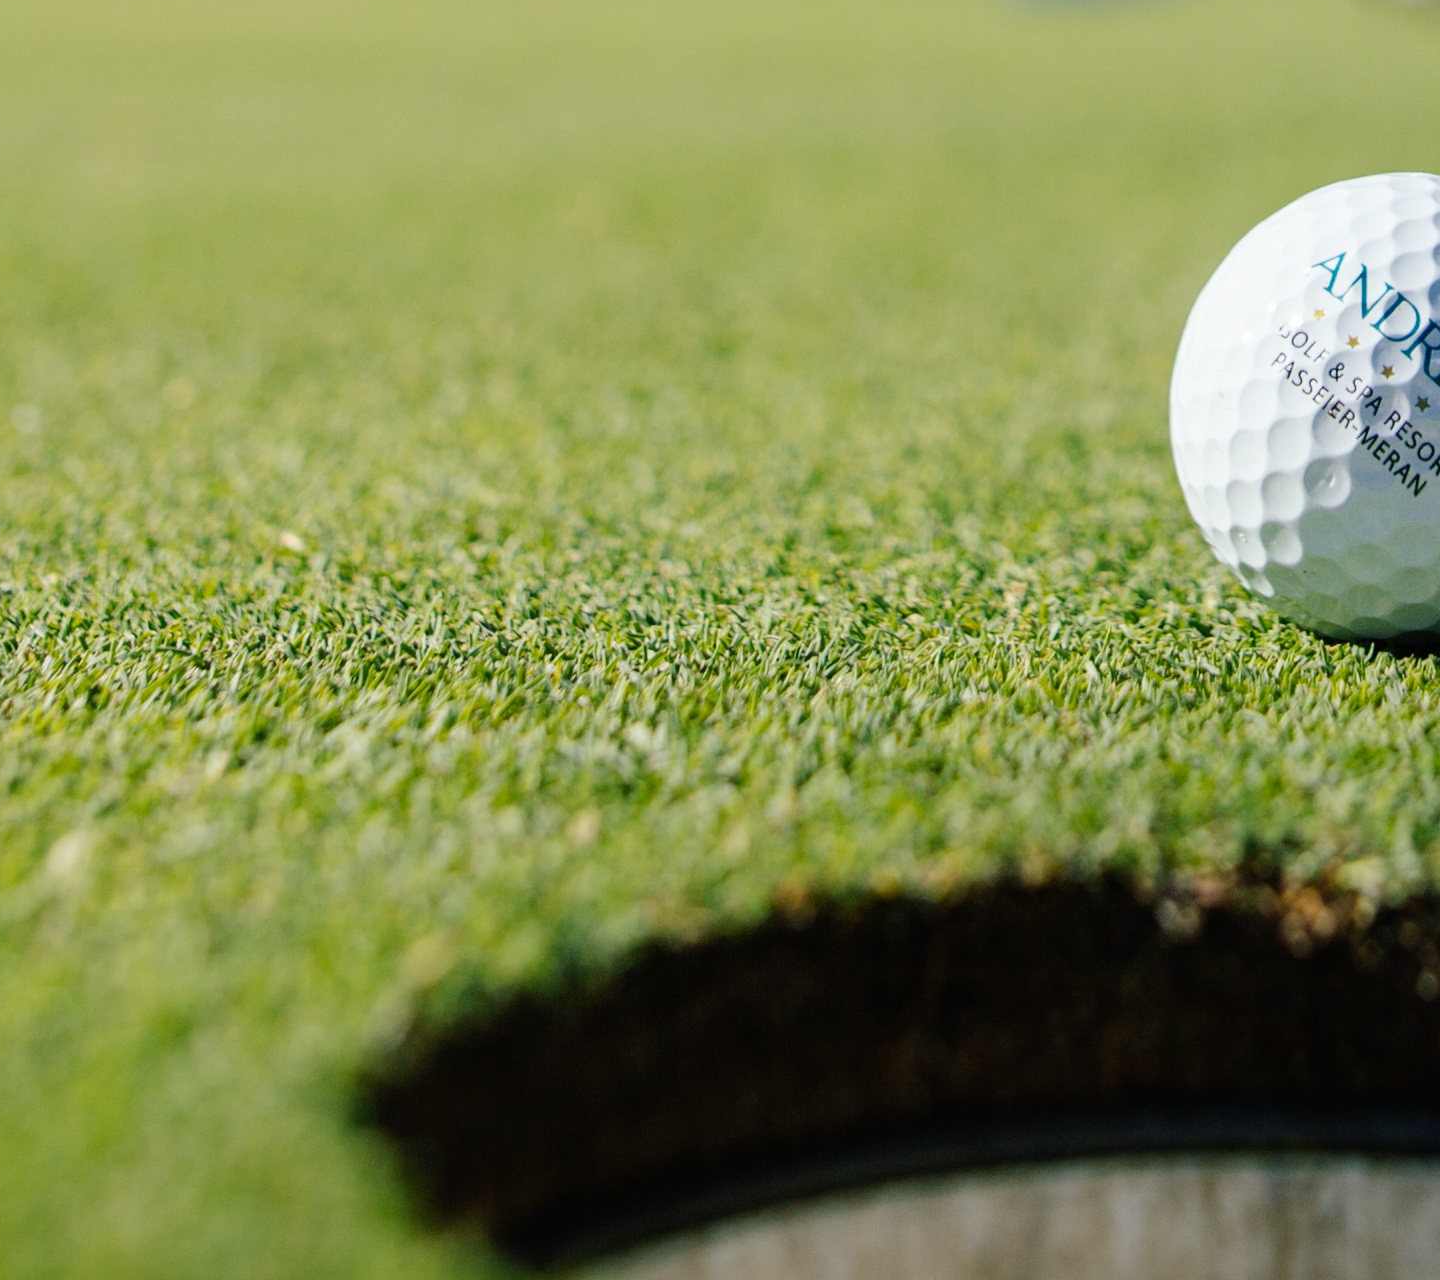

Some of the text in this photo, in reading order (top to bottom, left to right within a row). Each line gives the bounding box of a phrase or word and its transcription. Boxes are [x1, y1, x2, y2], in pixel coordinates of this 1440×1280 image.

[1271, 351, 1427, 498] PASSEIER-MERAN
[1328, 362, 1345, 382] &
[1346, 377, 1383, 417] SPA
